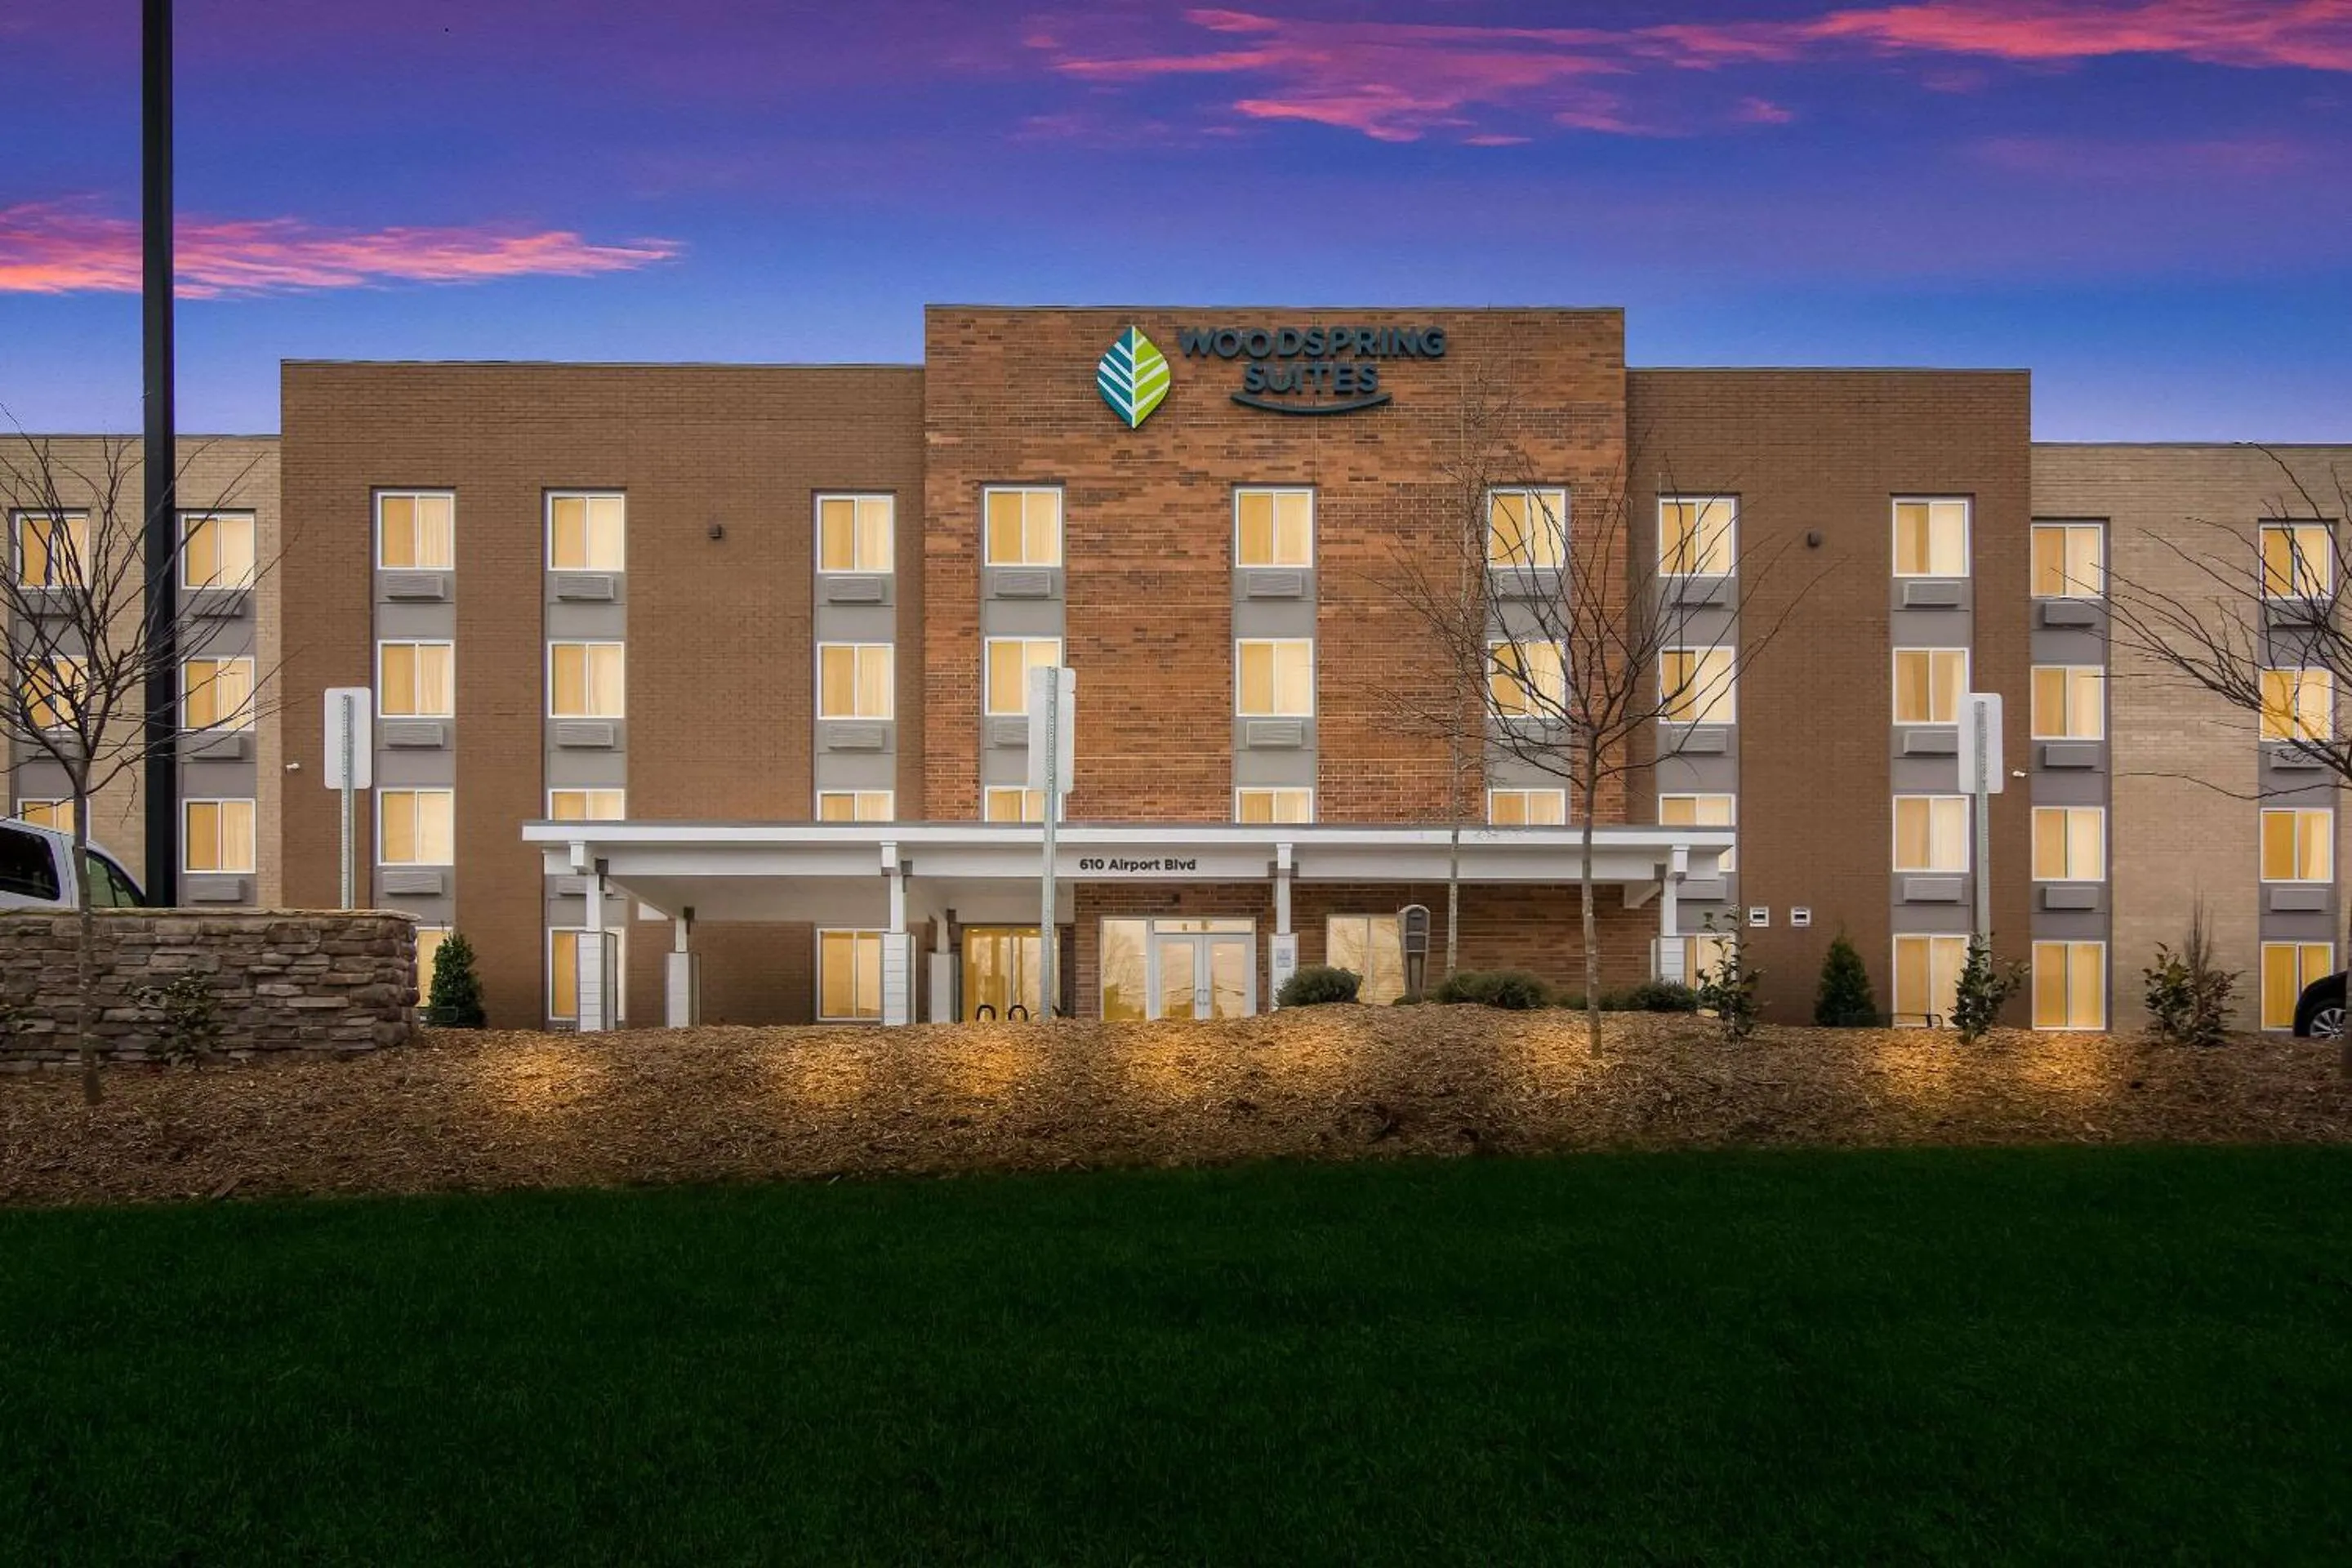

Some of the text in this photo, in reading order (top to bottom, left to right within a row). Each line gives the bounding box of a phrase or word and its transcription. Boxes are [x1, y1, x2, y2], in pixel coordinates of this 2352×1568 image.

[1178, 327, 1445, 358] WOODSPRING
[1244, 362, 1379, 393] SUITES
[1080, 858, 1196, 872] 610 Airport Blvd
